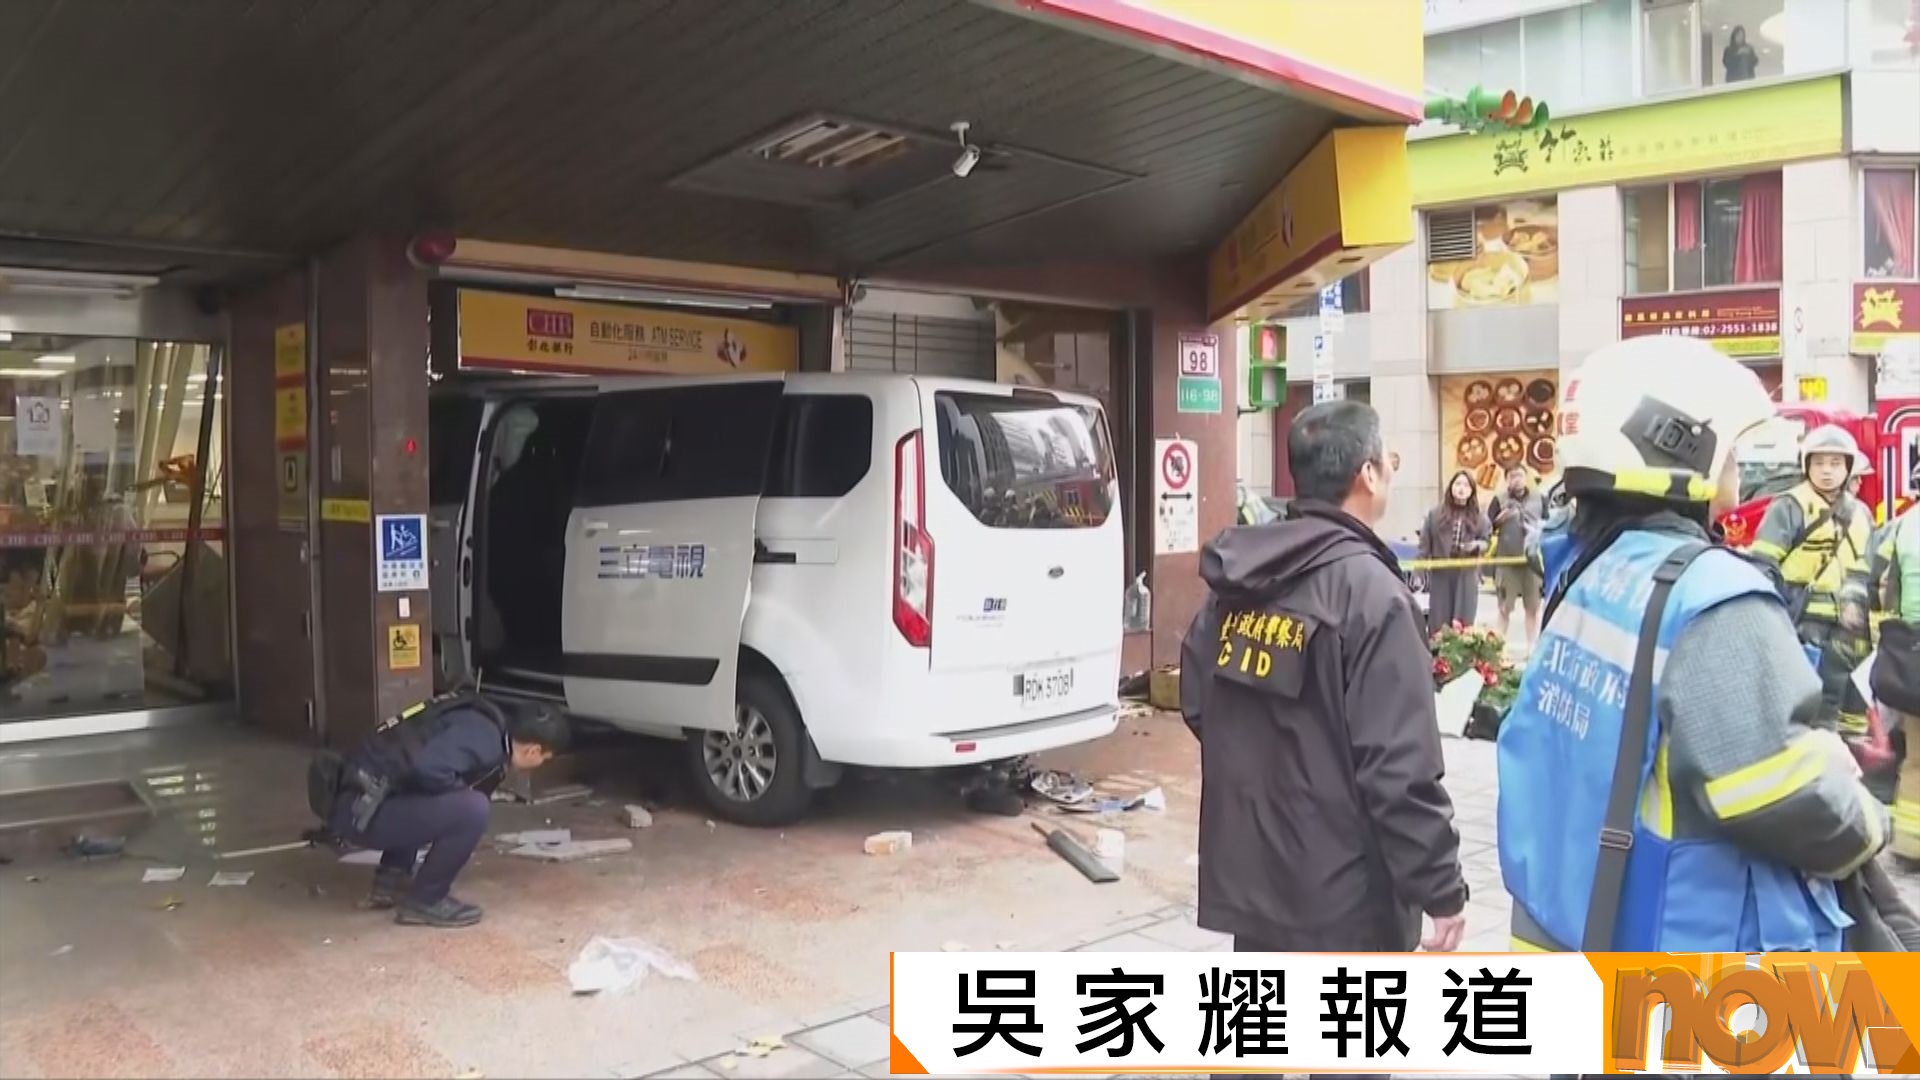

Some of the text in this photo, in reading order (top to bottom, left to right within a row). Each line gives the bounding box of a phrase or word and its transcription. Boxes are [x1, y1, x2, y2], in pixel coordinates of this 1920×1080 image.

[528, 310, 573, 338] CHB
[650, 325, 668, 344] ATM
[669, 328, 704, 349] SERVICE
[1189, 350, 1208, 371] 98
[597, 543, 705, 579] 三立電視
[1217, 641, 1272, 678] CID
[1538, 679, 1591, 741] 消防局
